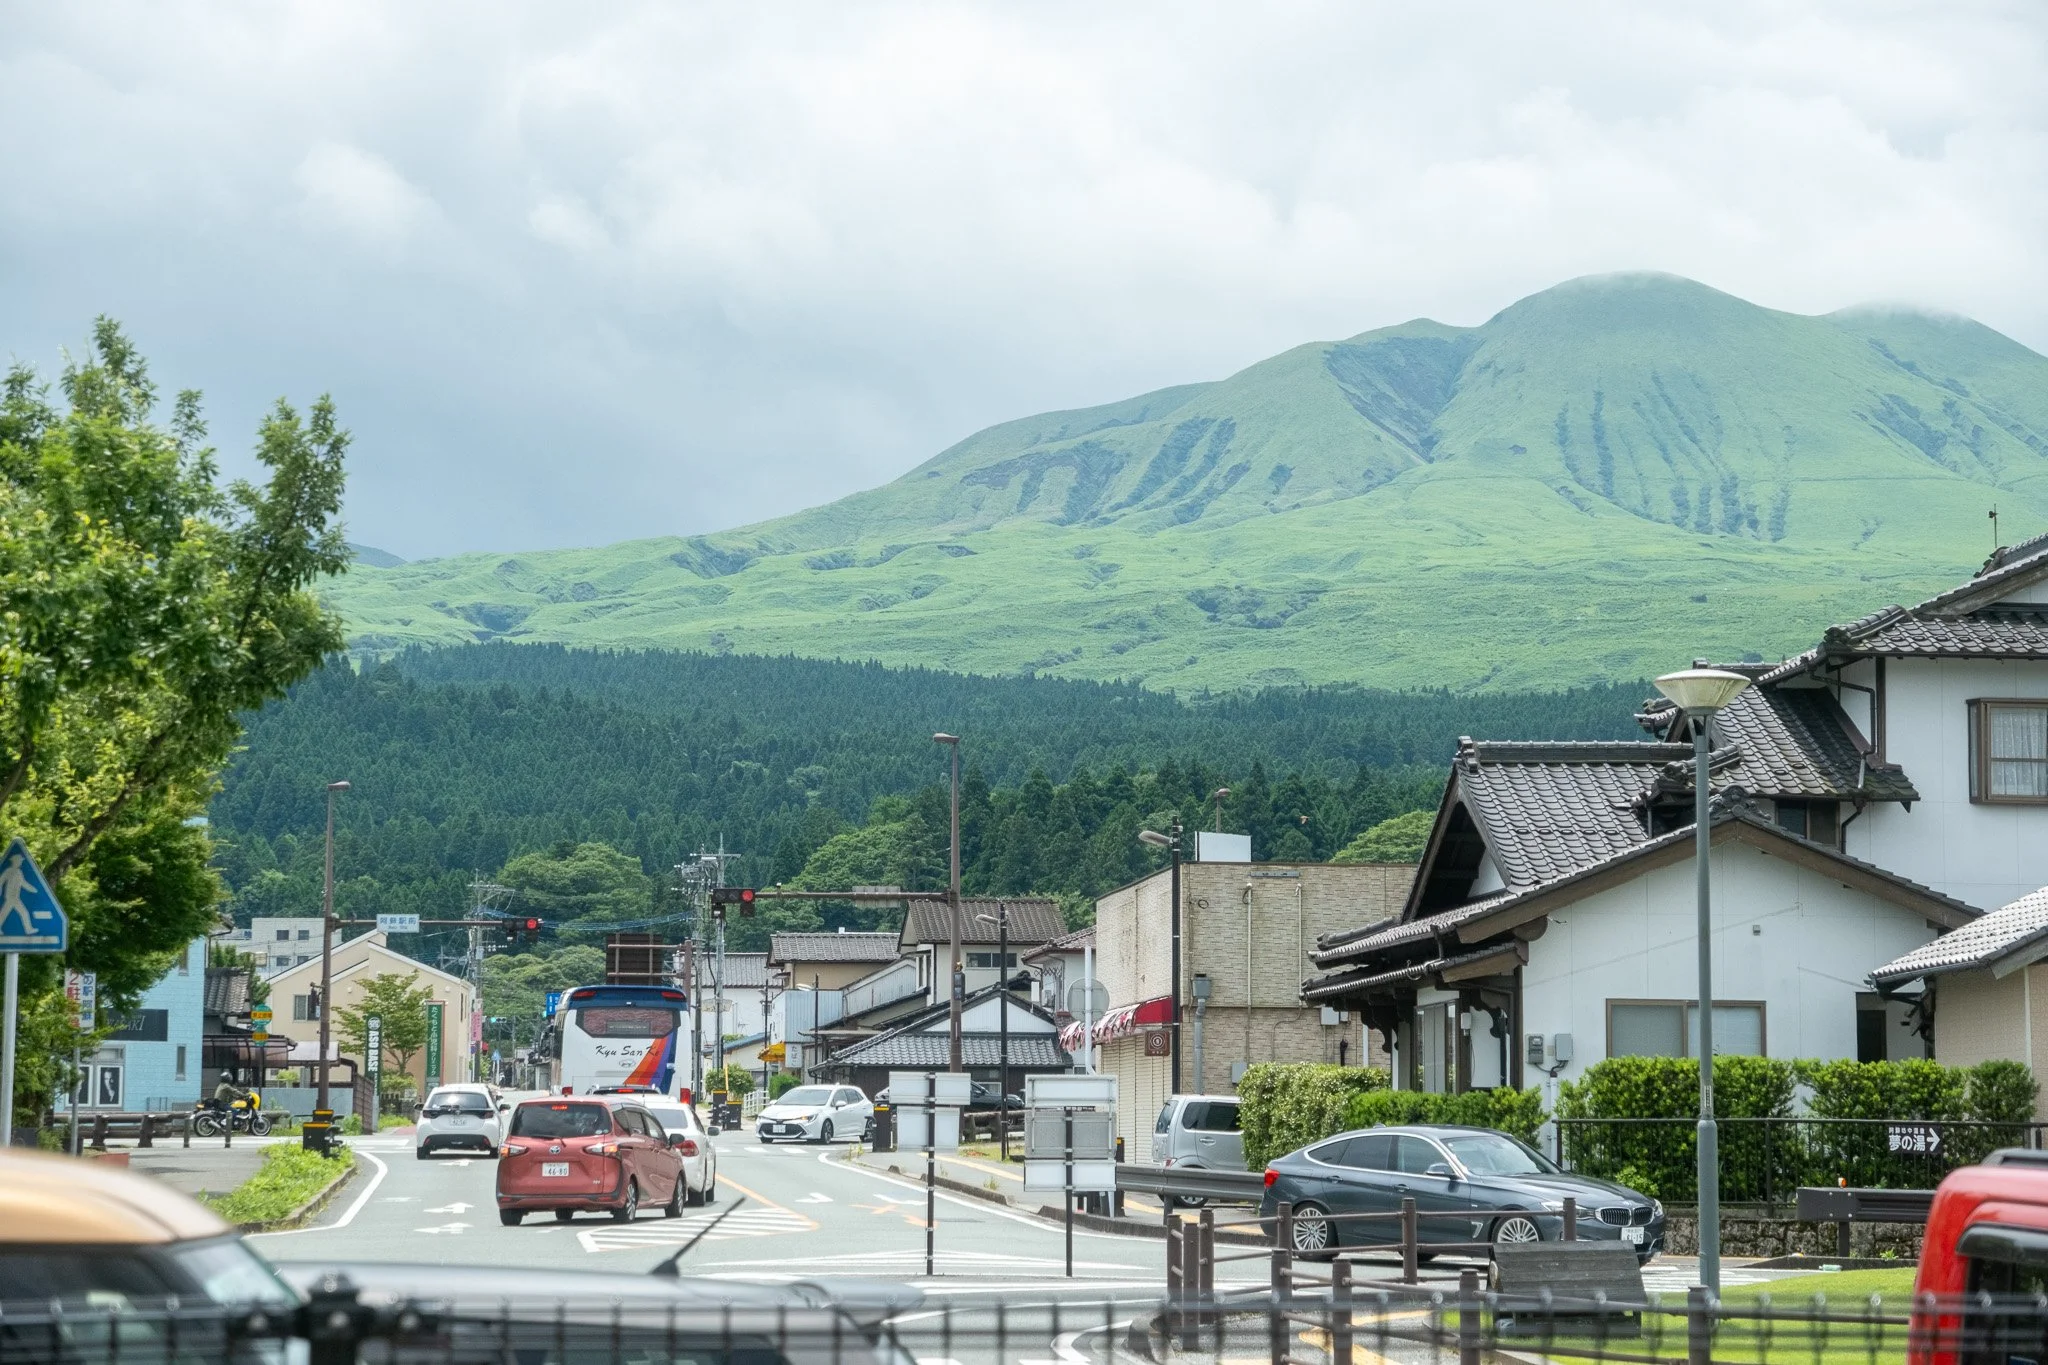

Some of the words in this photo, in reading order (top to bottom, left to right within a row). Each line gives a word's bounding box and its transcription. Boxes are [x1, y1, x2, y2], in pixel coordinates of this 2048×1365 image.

[368, 1031, 379, 1048] ASO
[595, 1045, 617, 1058] Kyu
[621, 1046, 643, 1056] San
[367, 1050, 379, 1072] BASE
[1889, 1135, 1926, 1151] 夢の湯
